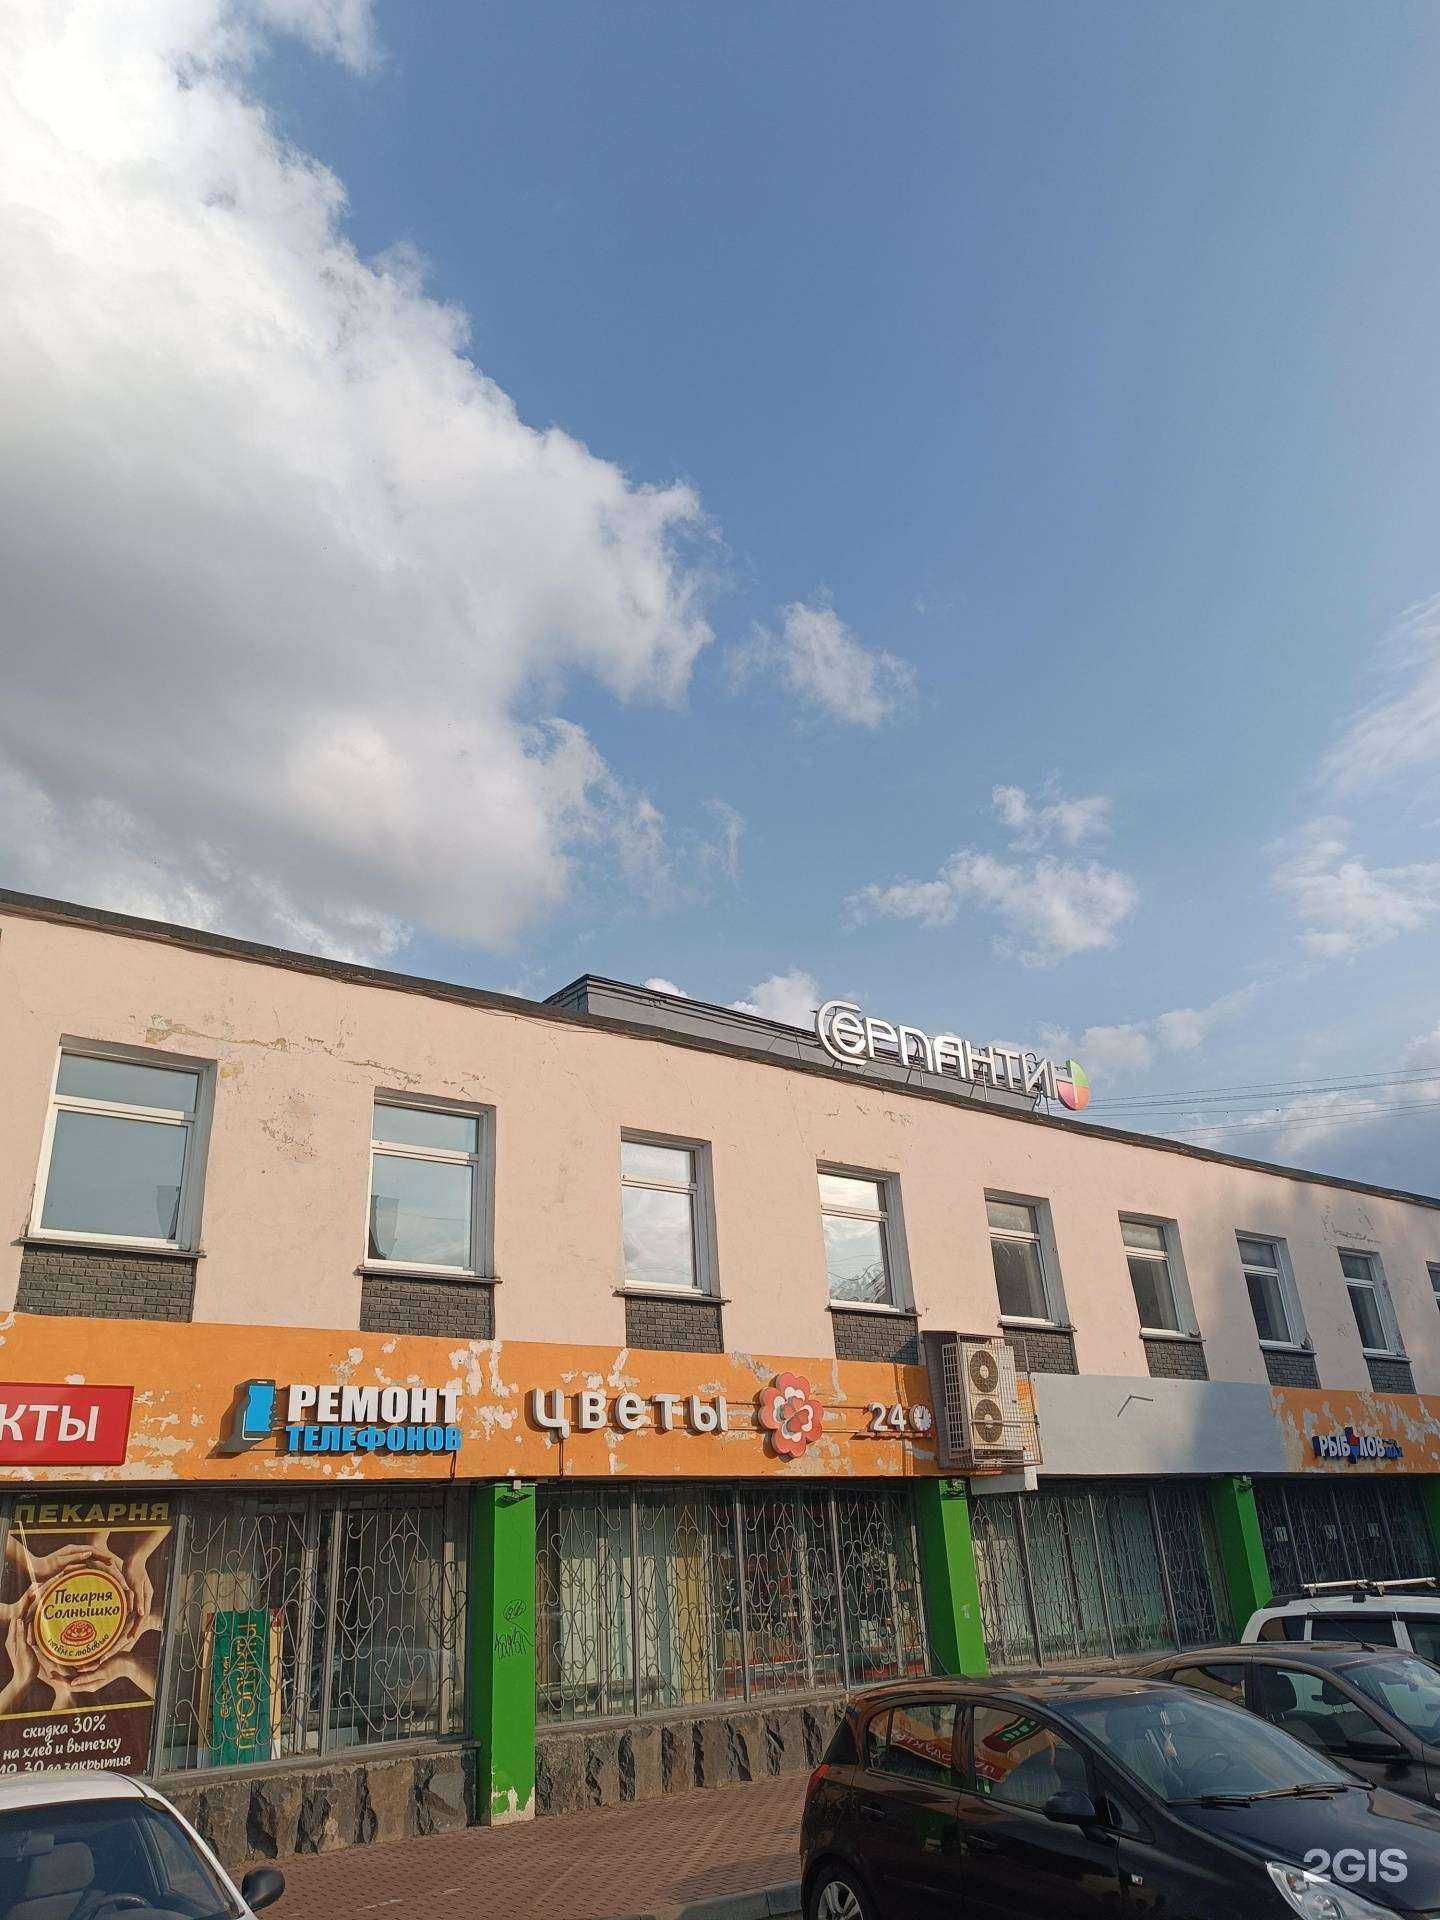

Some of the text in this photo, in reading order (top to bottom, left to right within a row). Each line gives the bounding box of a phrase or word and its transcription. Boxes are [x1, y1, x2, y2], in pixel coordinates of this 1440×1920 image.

[288, 1384, 462, 1423] РЕМОНТ
[286, 1426, 462, 1451] ТЕЛЕФОНОВ
[14, 1503, 169, 1523] ПЕКАРНЯ
[55, 1589, 113, 1607] Пекарня
[44, 1604, 120, 1620] Солнышко
[22, 1714, 107, 1741] скидка 30%
[3, 1737, 122, 1760] на хлеб и выпечку
